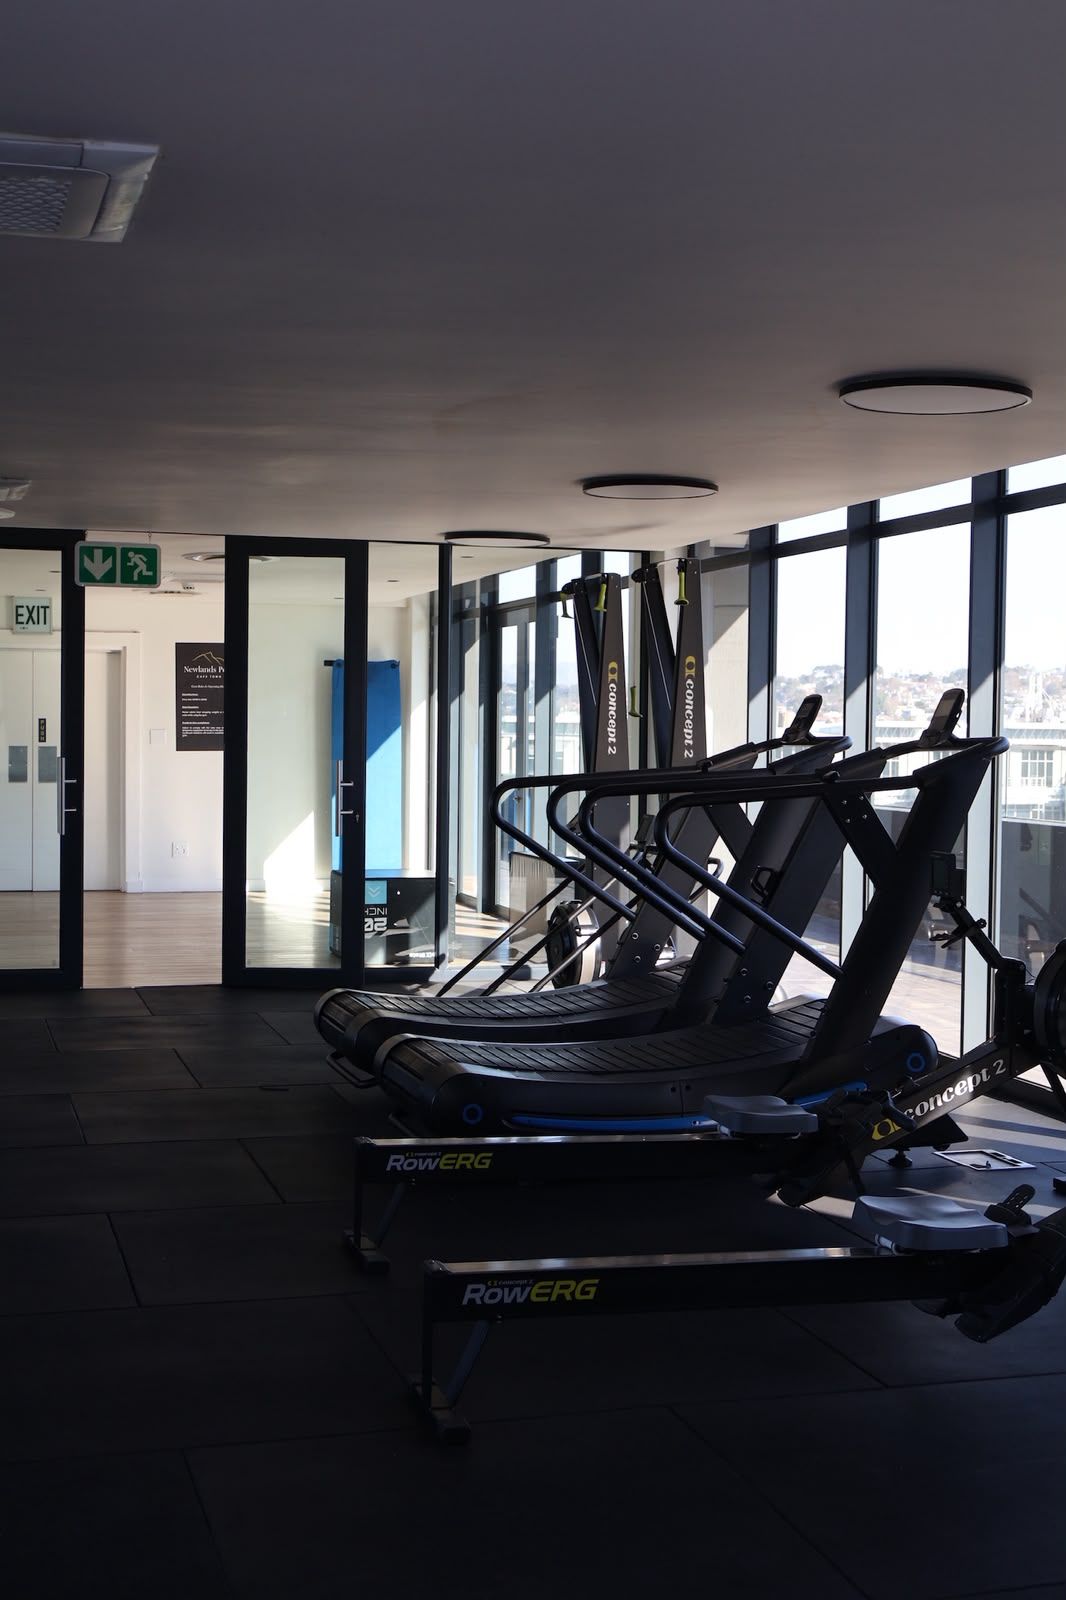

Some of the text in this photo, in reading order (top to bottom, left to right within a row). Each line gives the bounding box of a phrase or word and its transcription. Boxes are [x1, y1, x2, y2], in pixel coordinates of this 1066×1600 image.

[15, 605, 50, 625] EXIT
[183, 665, 217, 673] Newlands
[607, 683, 617, 756] concept 2
[684, 679, 694, 759] concept 2
[904, 1059, 1007, 1119] concept 2
